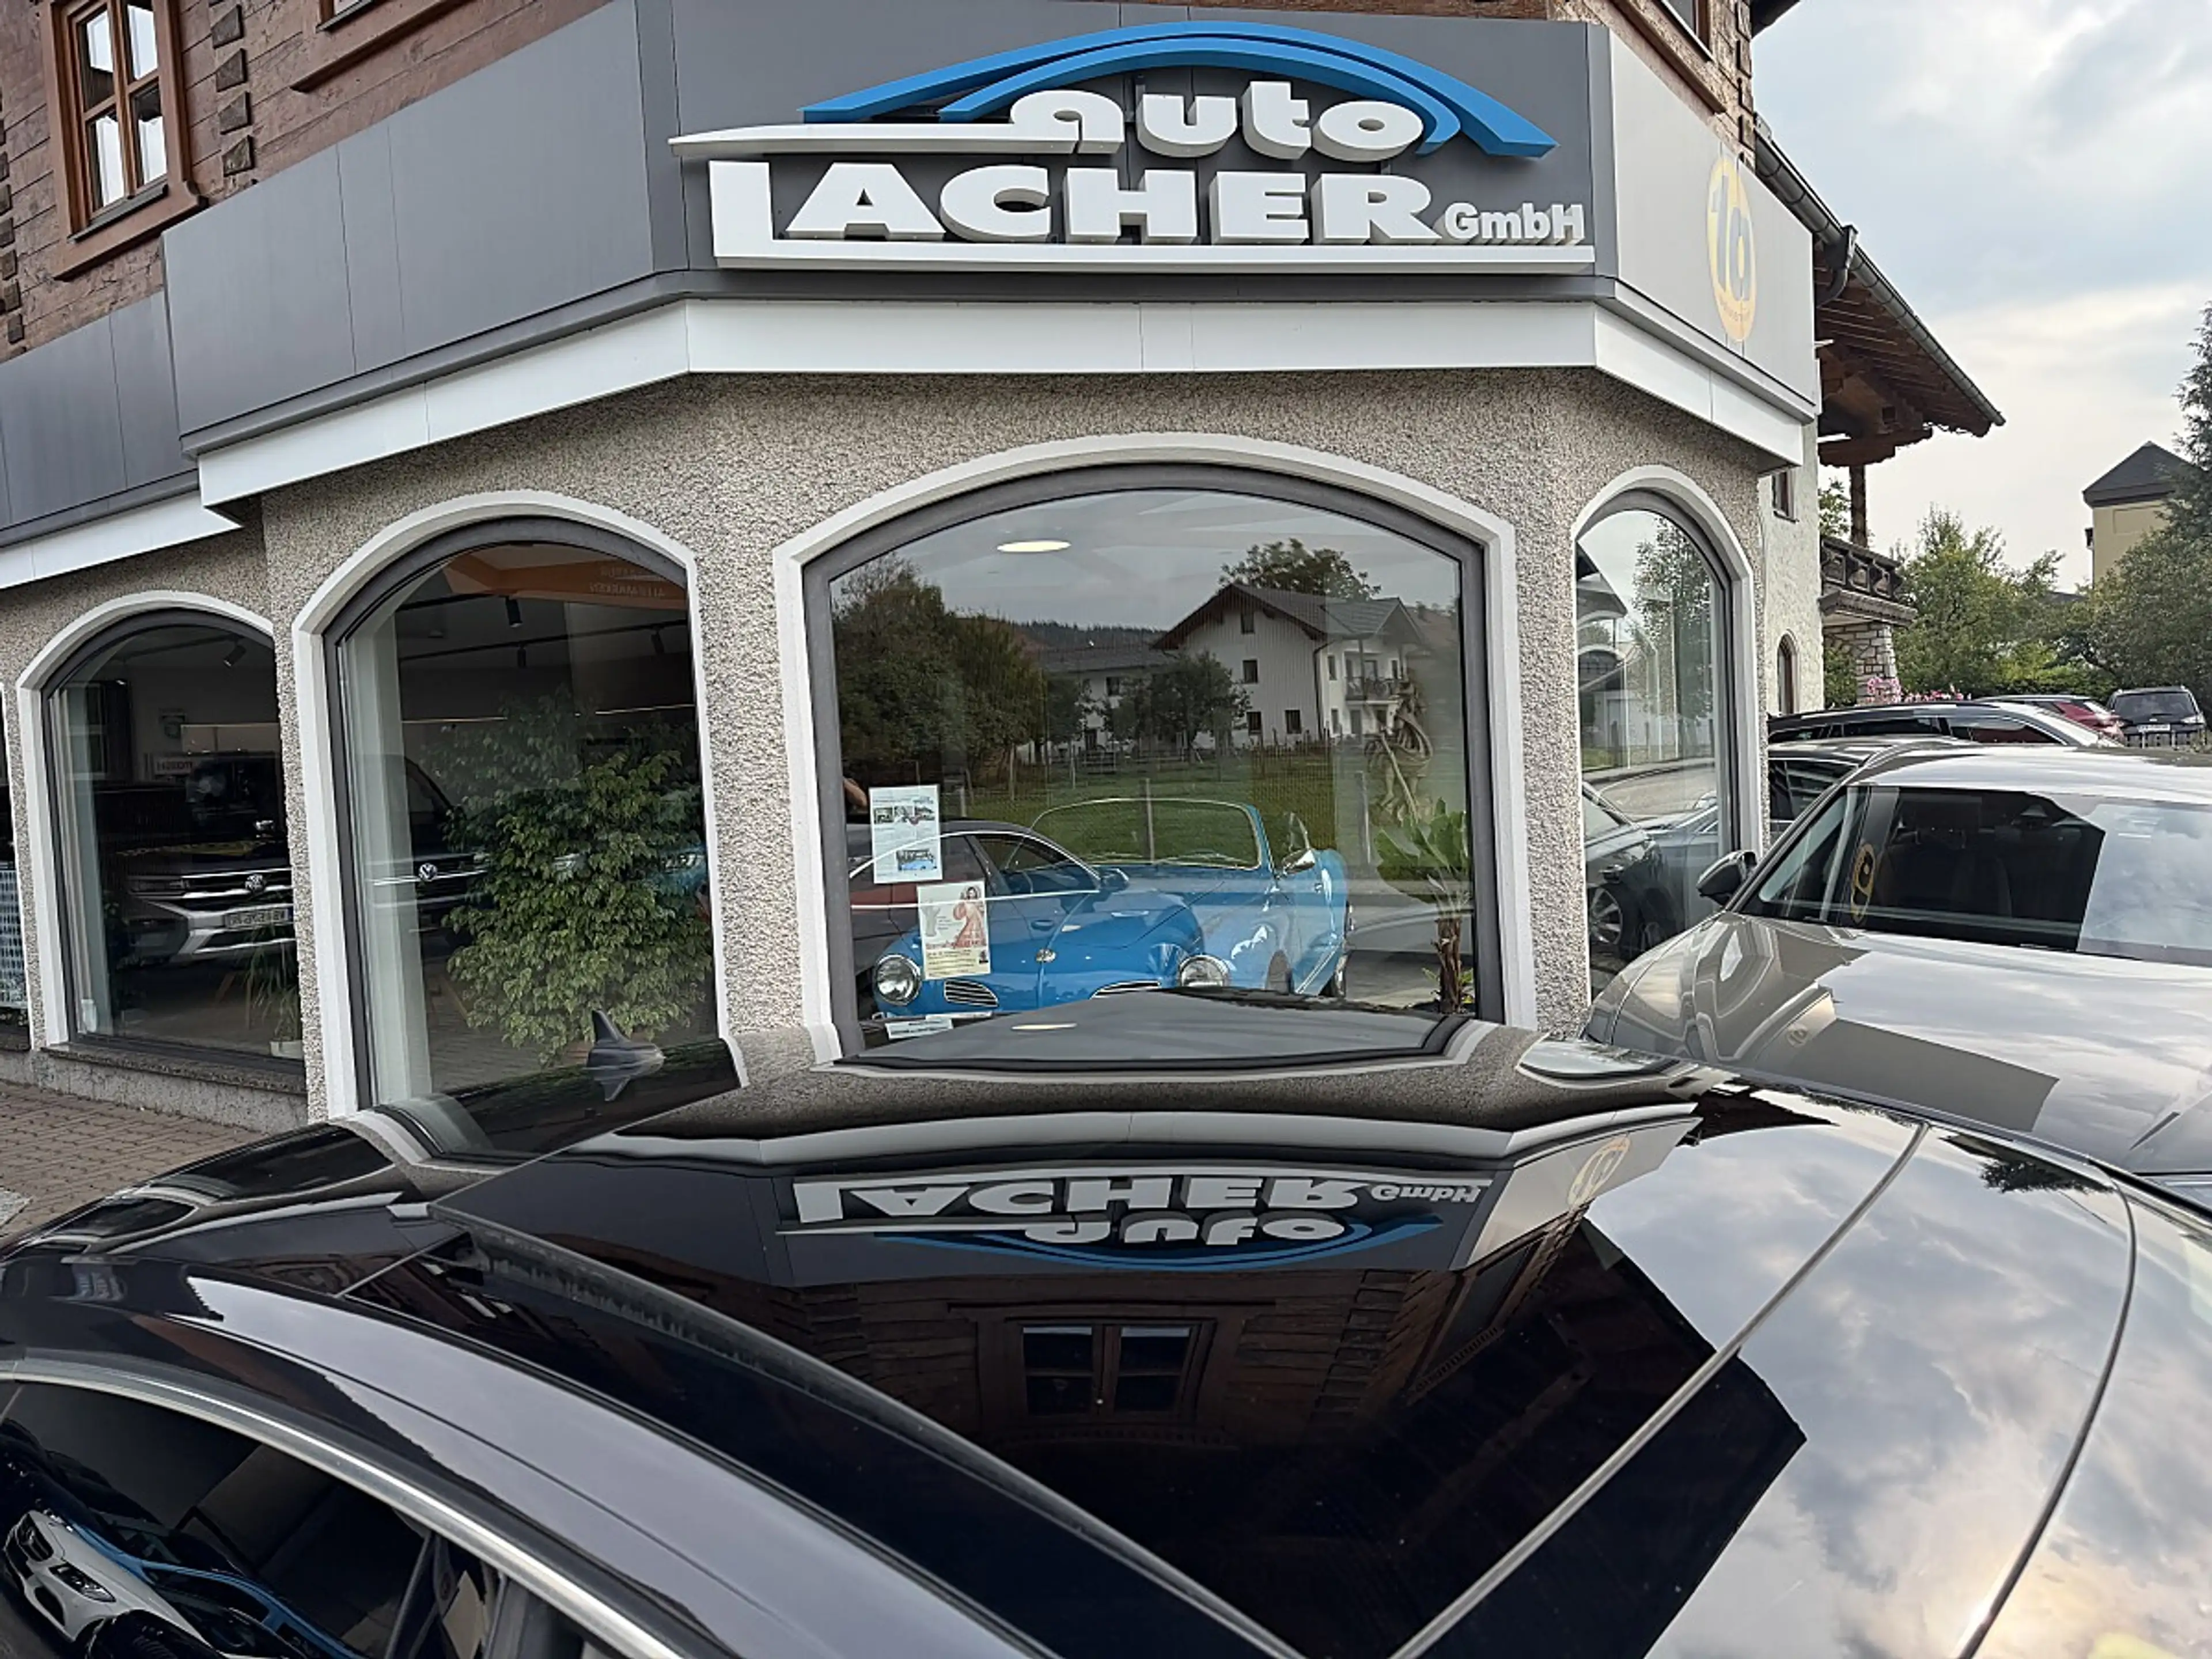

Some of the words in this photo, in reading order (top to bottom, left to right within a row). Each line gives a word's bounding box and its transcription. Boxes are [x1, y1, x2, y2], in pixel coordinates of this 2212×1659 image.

[1010, 81, 1424, 162] auto
[709, 160, 1442, 268] LACHER
[1441, 202, 1586, 246] GmbH
